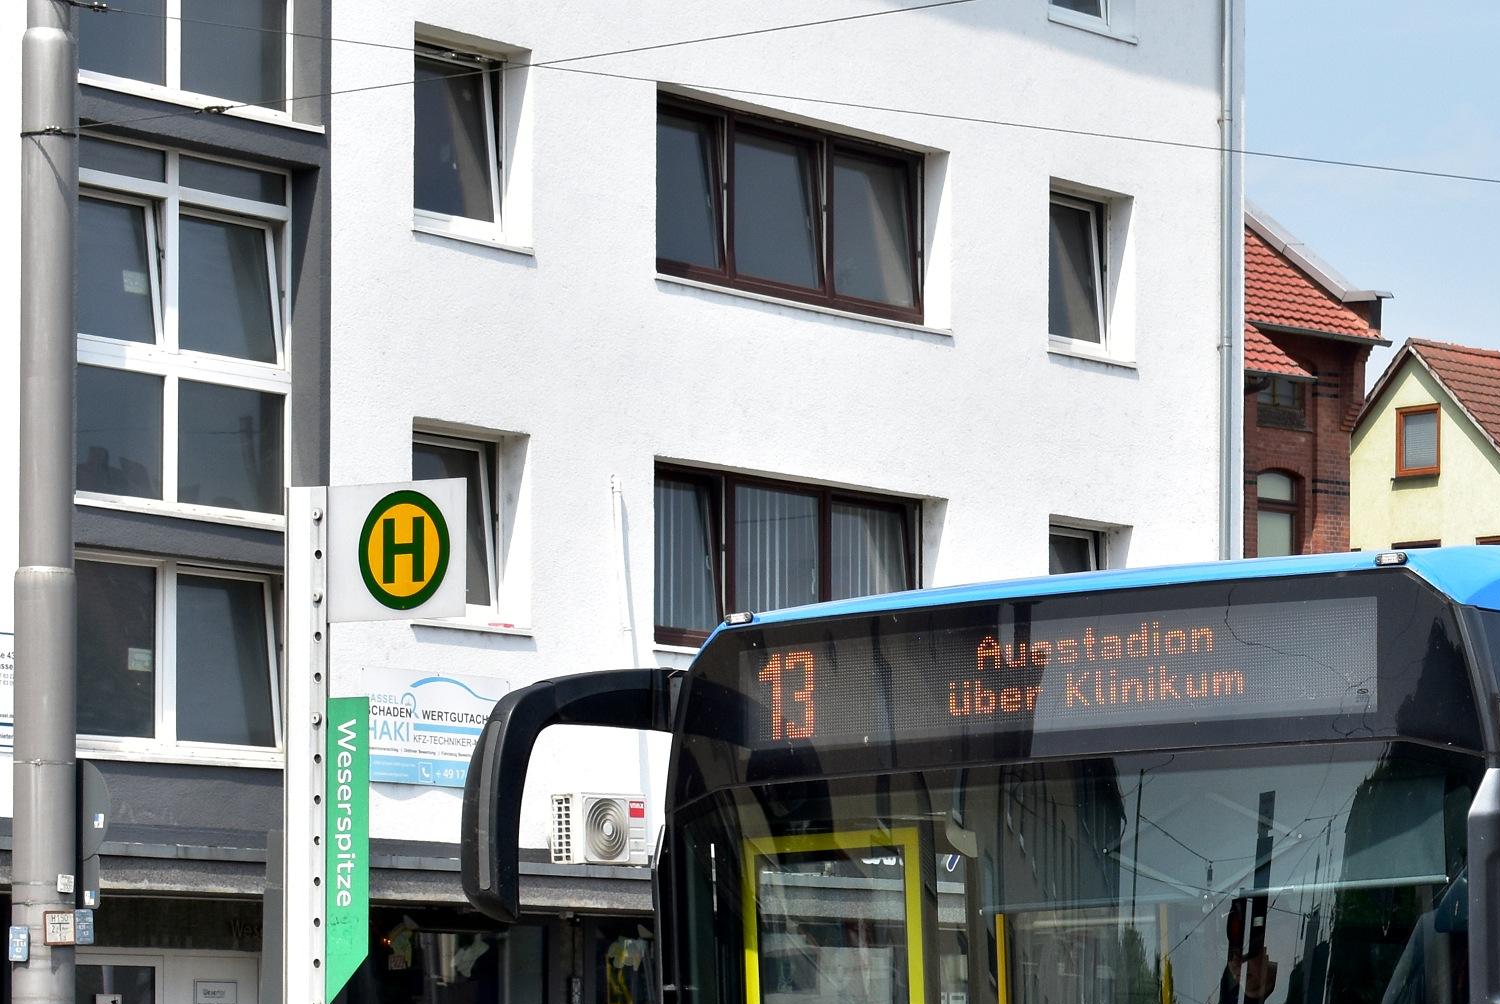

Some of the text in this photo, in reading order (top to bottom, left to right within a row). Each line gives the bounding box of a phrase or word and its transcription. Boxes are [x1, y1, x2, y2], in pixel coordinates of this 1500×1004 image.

[383, 516, 424, 584] H
[975, 622, 1214, 671] Auestadion
[366, 693, 399, 705] ASSEL
[758, 650, 816, 741] 13
[948, 665, 1246, 718] über Klinikum
[335, 718, 357, 908] Weserspitze
